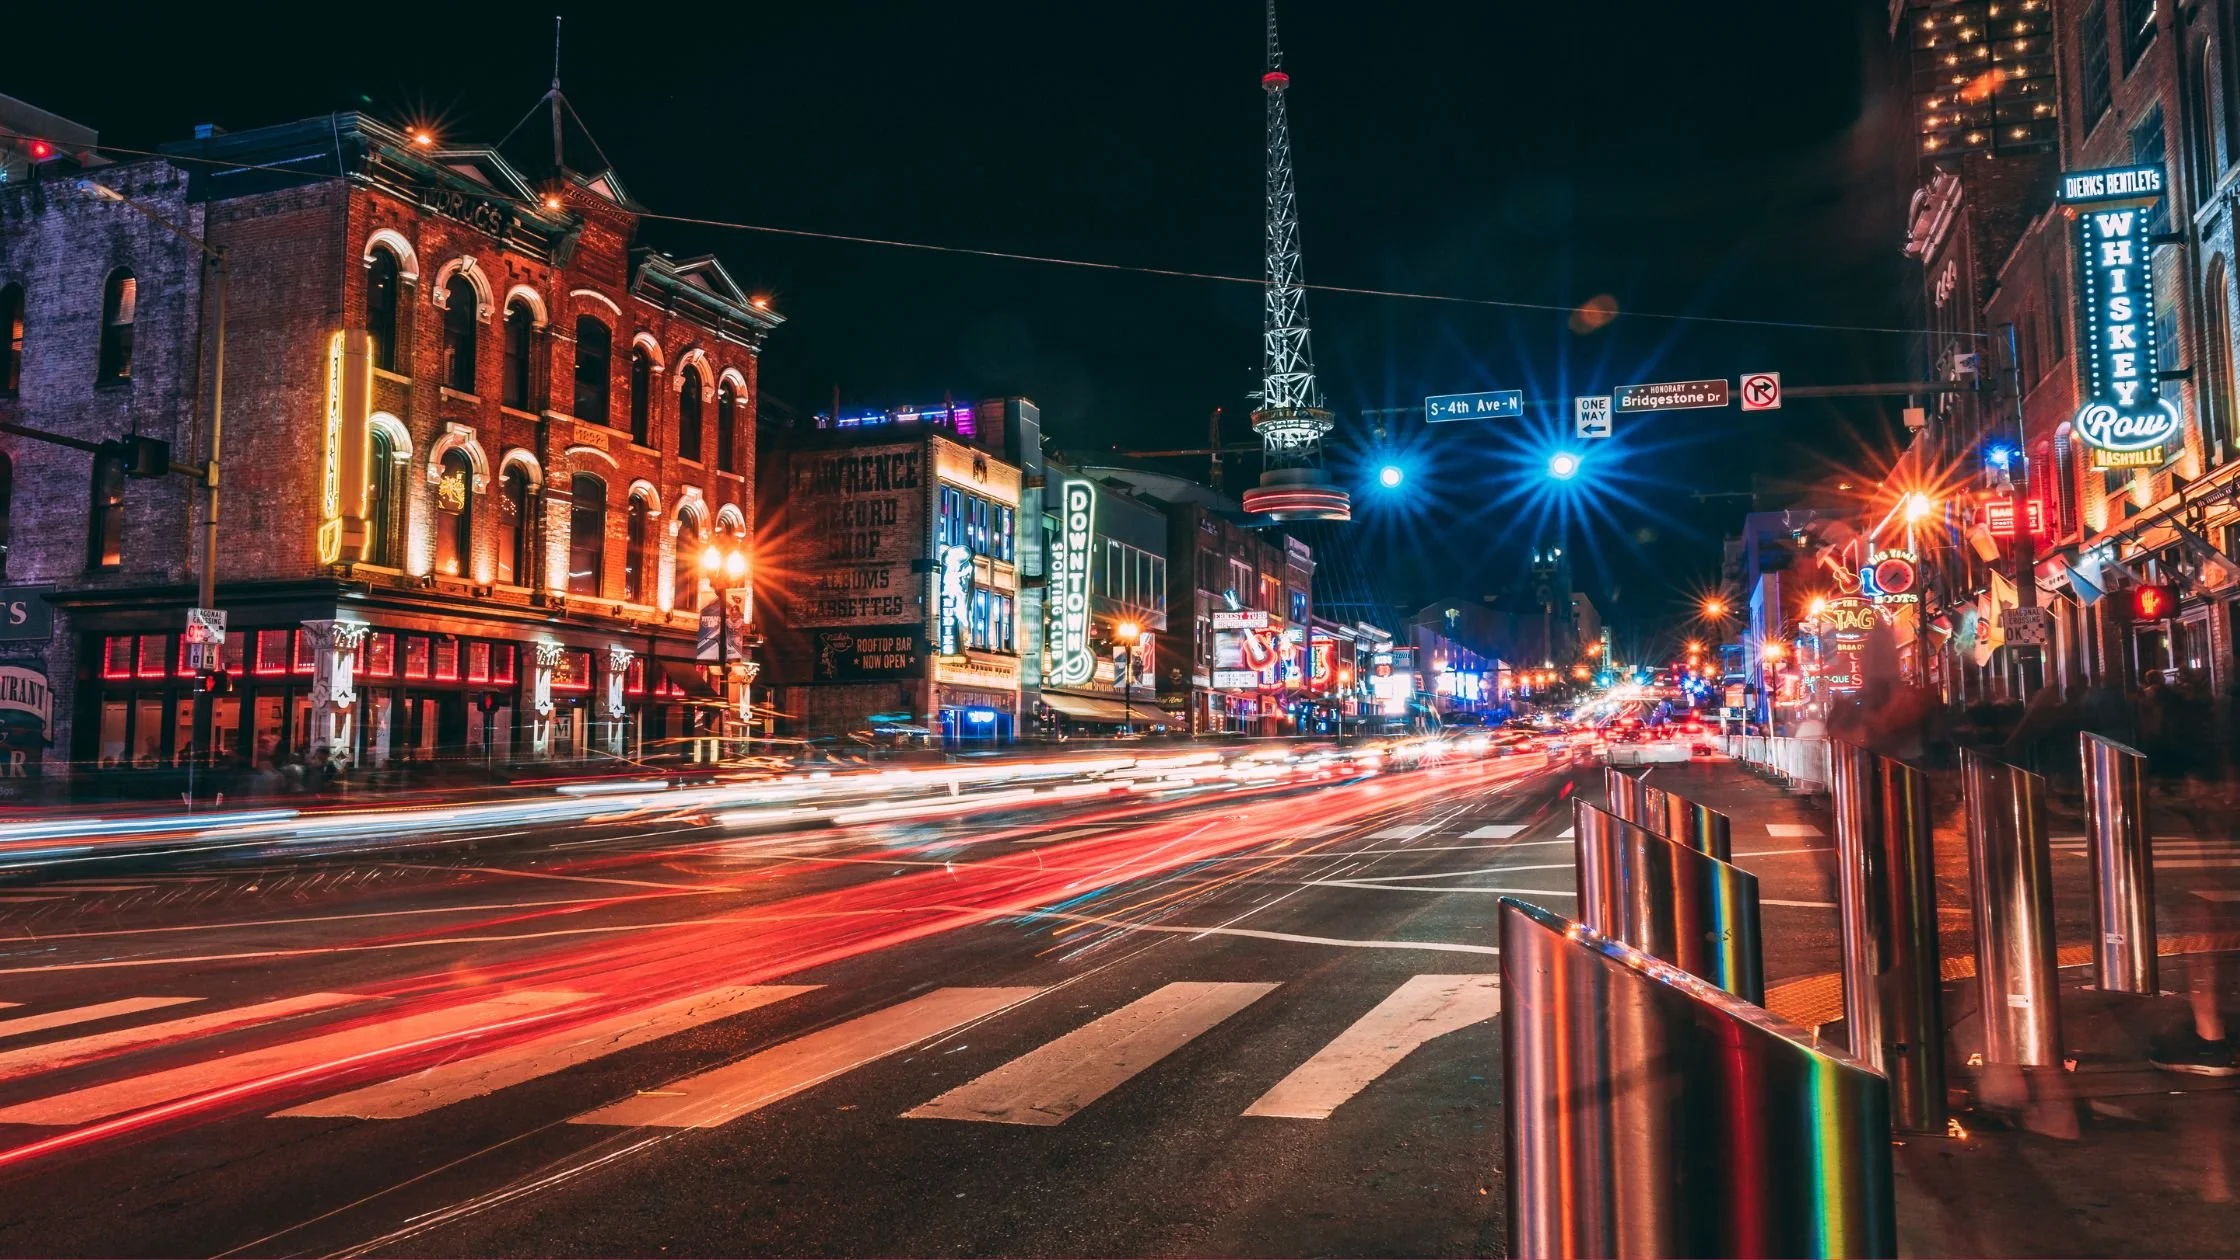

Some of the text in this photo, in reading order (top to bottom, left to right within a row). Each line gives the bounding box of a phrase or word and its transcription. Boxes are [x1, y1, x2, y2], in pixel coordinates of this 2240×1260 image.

[2066, 175, 2104, 199] DIERKS
[2095, 212, 2138, 406] WHISKEY
[1650, 384, 1686, 394] HONORARY
[1430, 396, 1518, 416] S-4th Ave-N
[1581, 399, 1606, 410] ONE
[1621, 391, 1721, 408] Bridgestone Dr
[1581, 410, 1606, 422] WAY
[2085, 405, 2170, 446] Row
[2097, 447, 2163, 467] NASHVILLE
[790, 453, 919, 495] LAWRENCE
[814, 500, 897, 528] RECORD
[828, 530, 881, 560] SHOP
[1891, 549, 1918, 564] TIME
[818, 569, 890, 590] ALBUMS
[1067, 490, 1088, 652] DOWNTOWN
[805, 597, 904, 618] CASSETTES
[1051, 543, 1064, 660] SPORTING CLUB
[1874, 594, 1919, 604] BOOTS
[1214, 611, 1267, 620] ERNEST TUBB
[2008, 616, 2041, 625] CROSSING
[2006, 626, 2023, 641] OK
[856, 638, 894, 652] ROOFTOP
[895, 637, 912, 651] BAR
[863, 654, 906, 669] NOW OPEN
